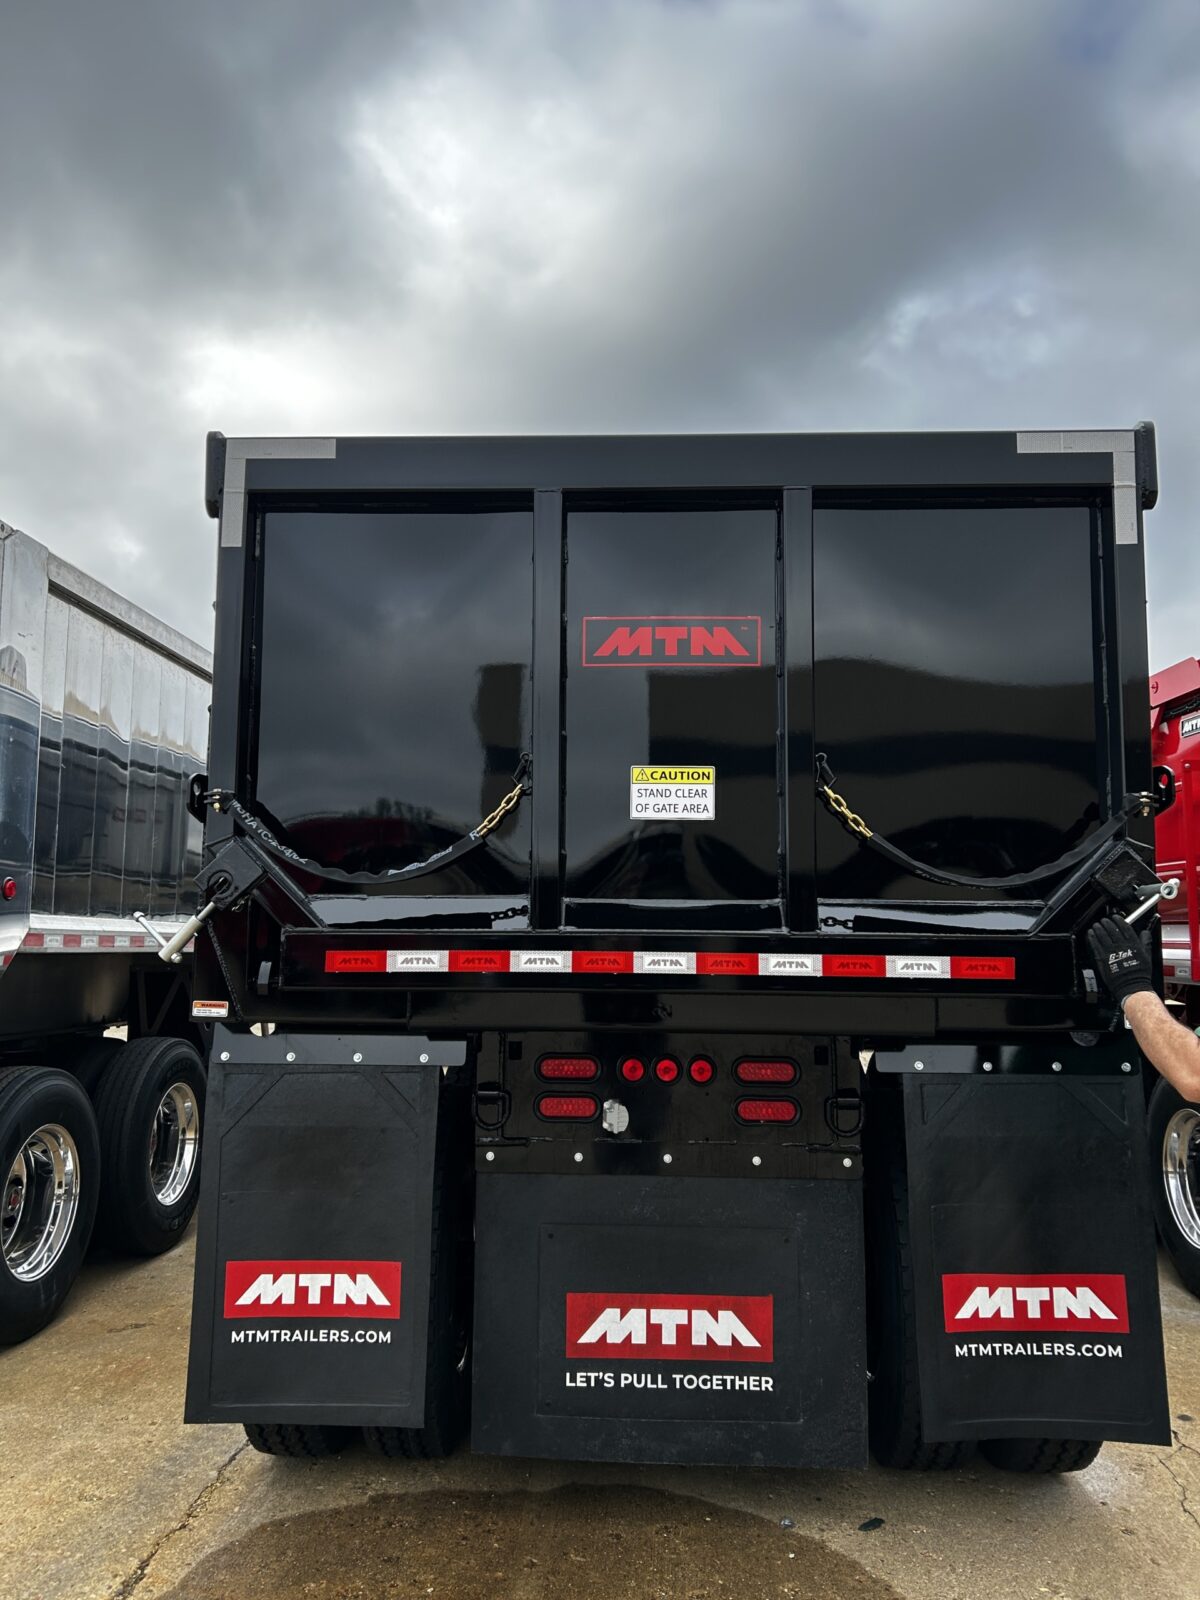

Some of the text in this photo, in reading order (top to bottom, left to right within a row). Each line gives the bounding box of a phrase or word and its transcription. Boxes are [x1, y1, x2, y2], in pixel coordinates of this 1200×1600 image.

[593, 626, 750, 656] MTM
[1182, 720, 1200, 733] MT
[650, 771, 711, 781] CAUTION
[637, 788, 708, 798] STAND CLEAR
[635, 803, 710, 813] OF GATE AREA
[338, 957, 1001, 972] MTM MTM MTM MTM MTM MTM MTM MTM MTM MTM MTM
[235, 1273, 391, 1306] MTM
[954, 1286, 1119, 1320] MTM
[577, 1308, 762, 1348] MTM
[231, 1329, 392, 1344] MTMTRAILERS.COM
[955, 1343, 1123, 1358] MTMTRAILERS.COM
[565, 1372, 774, 1391] LET'S PULL TOGETHER
